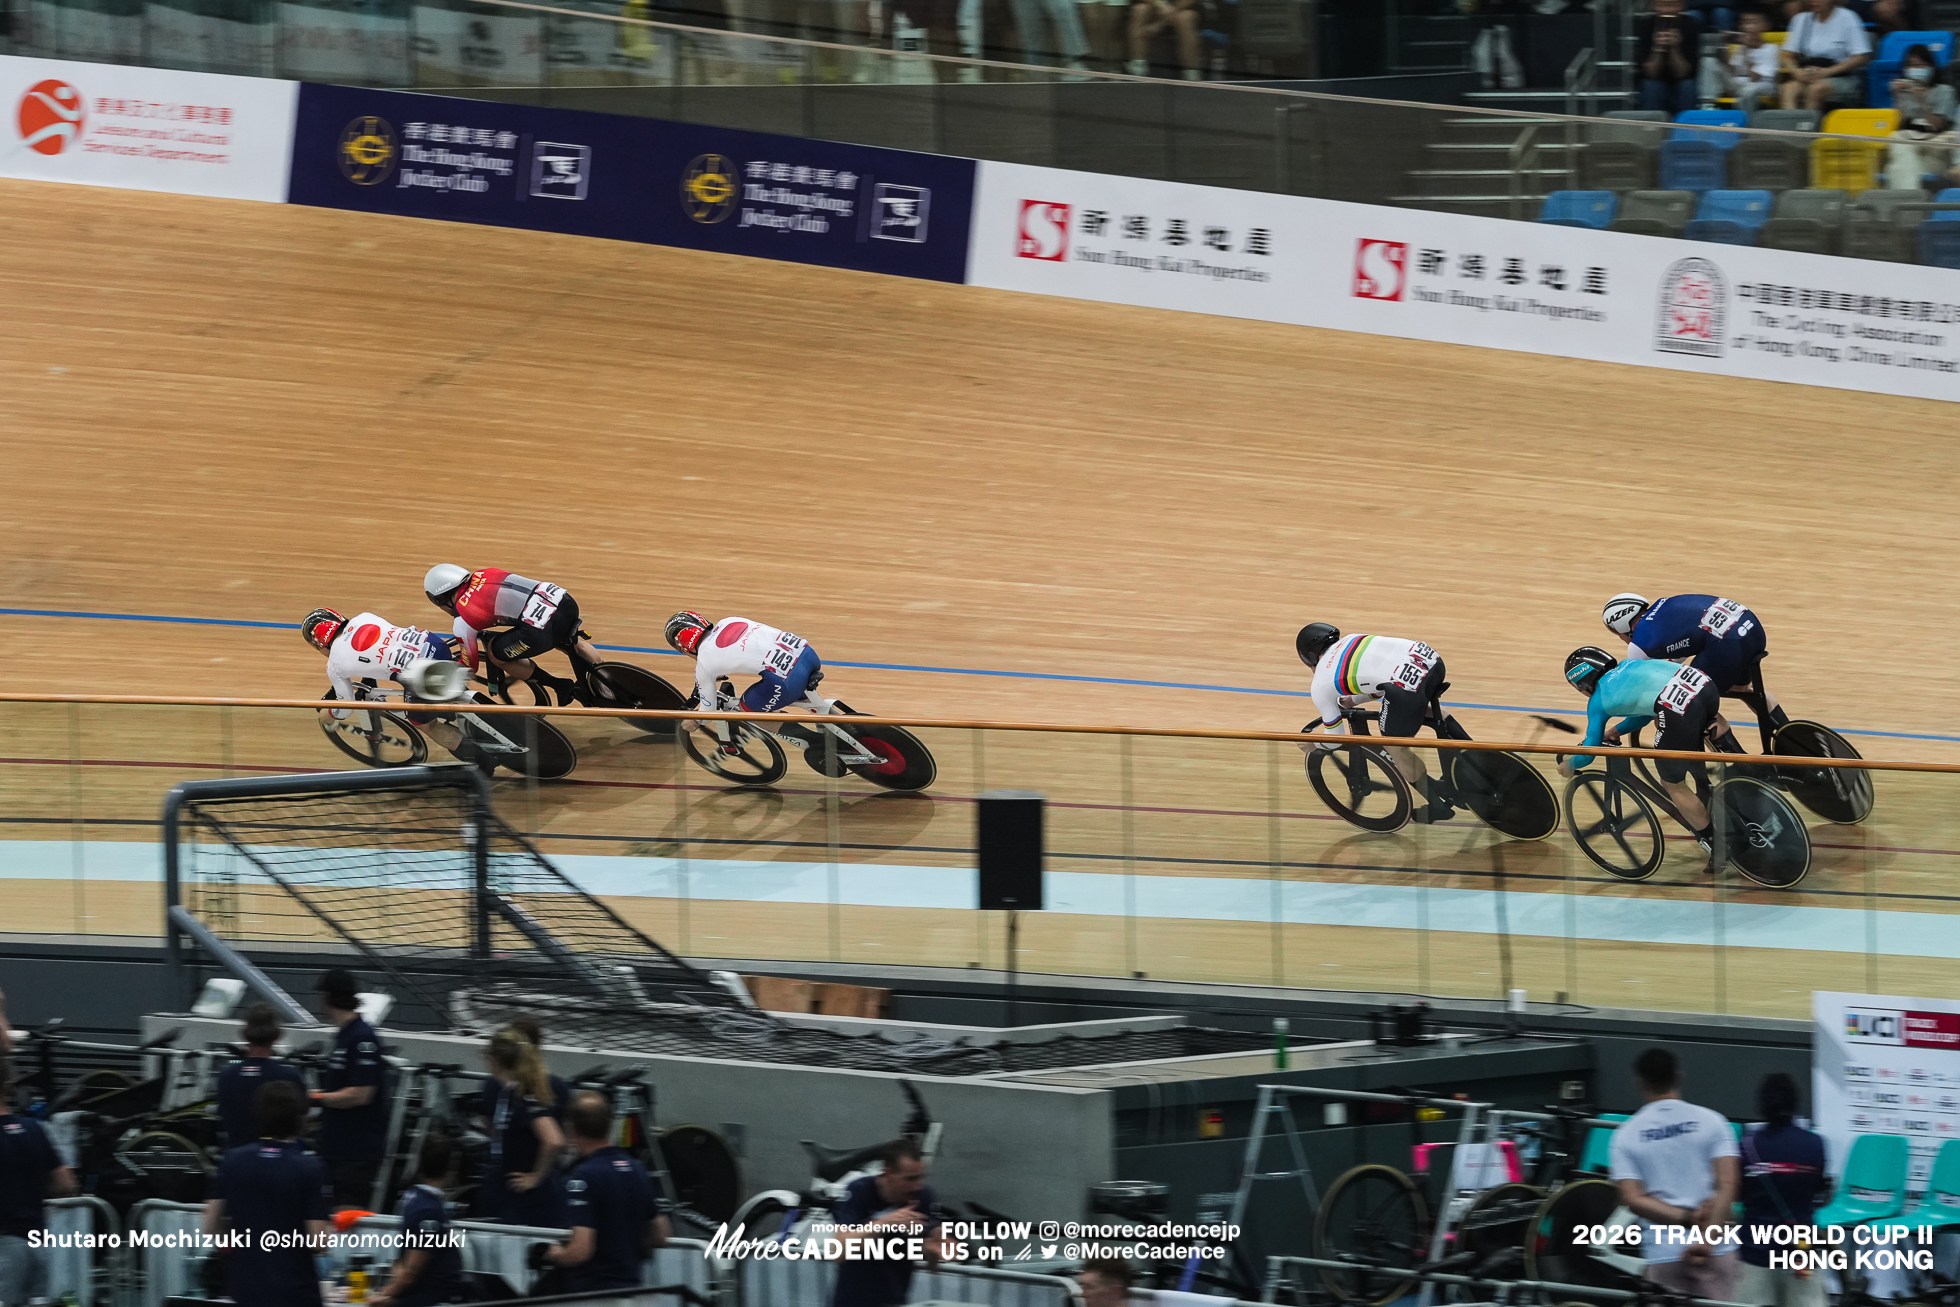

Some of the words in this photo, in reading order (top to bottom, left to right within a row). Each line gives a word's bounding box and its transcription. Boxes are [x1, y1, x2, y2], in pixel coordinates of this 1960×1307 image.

[401, 145, 432, 163] The
[432, 148, 471, 171] Hong
[470, 152, 513, 176] Kong
[397, 169, 449, 193] Jockey
[449, 173, 489, 192] Club
[743, 184, 774, 201] The
[774, 187, 812, 211] Hong
[811, 192, 854, 216] Kong
[738, 208, 790, 233] Jockey
[790, 213, 829, 233] Club
[1074, 246, 1106, 264] Sun
[1109, 250, 1153, 272] Hung
[1155, 255, 1184, 273] Kai
[1185, 259, 1271, 282] Properties
[1410, 286, 1443, 303] Sun
[1445, 289, 1490, 312] Hung
[1492, 294, 1520, 312] Kai
[1521, 298, 1608, 322] Properties
[1750, 310, 1780, 328] The
[1782, 314, 1846, 338] Cycling
[1852, 322, 1946, 346] Association
[1730, 334, 1749, 349] of
[1754, 338, 1795, 357] Hong
[1846, 346, 1892, 366] China
[458, 571, 485, 607] CHINA
[530, 603, 547, 621] 74
[1606, 605, 1635, 625] LAZER
[1708, 611, 1728, 629] 93
[323, 622, 337, 643] JAPAN
[688, 629, 701, 649] JAPAN
[376, 627, 398, 663] JAPAN
[504, 640, 531, 659] CHINA
[1667, 638, 1690, 653] FRANCE
[394, 649, 414, 668] 142
[770, 649, 793, 672] 143
[1399, 663, 1422, 686] 155
[761, 684, 782, 712] JAPAN
[1667, 683, 1689, 706] 119
[1857, 1014, 1899, 1038] UCI
[1640, 1121, 1699, 1143] FRANCE
